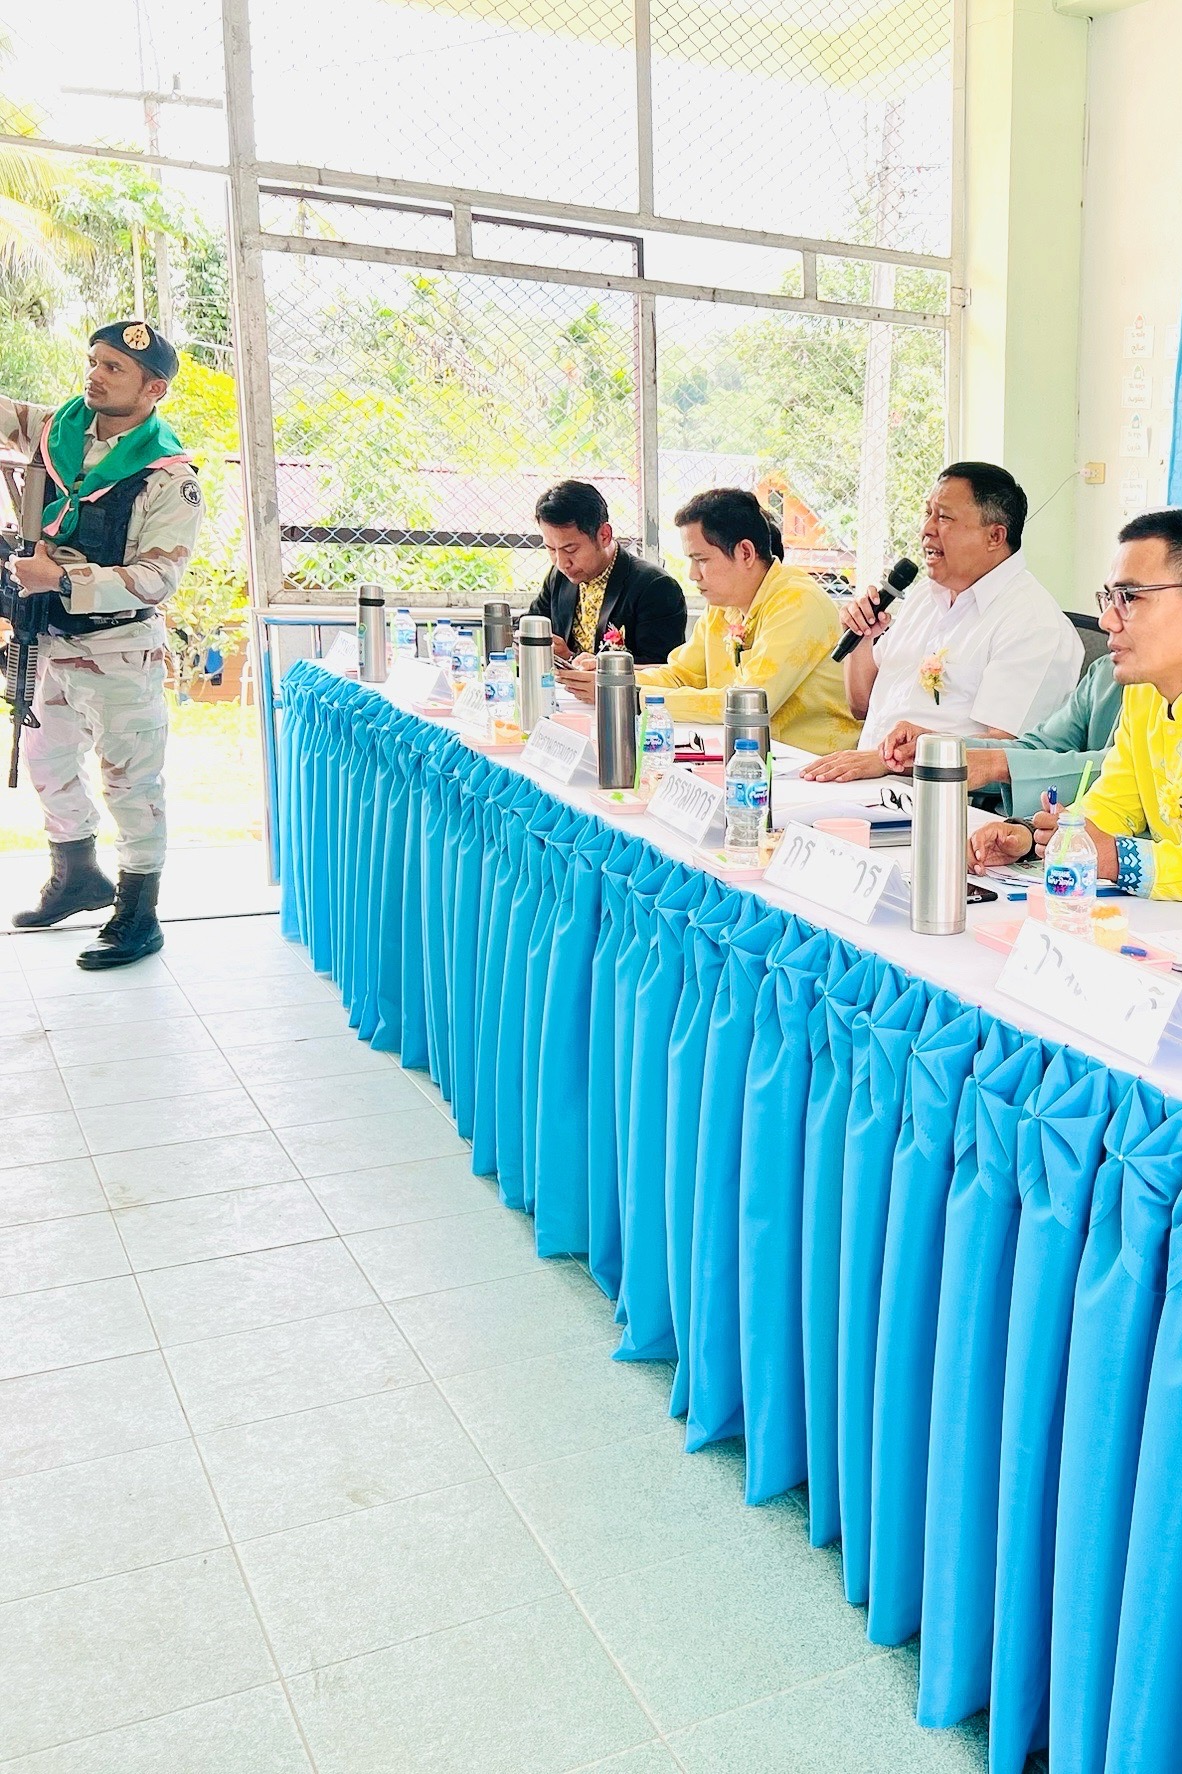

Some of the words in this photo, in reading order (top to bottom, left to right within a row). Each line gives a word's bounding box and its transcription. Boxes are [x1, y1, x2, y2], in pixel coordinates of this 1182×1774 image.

[659, 774, 716, 821] กรรมการ
[783, 835, 883, 898] กราร
